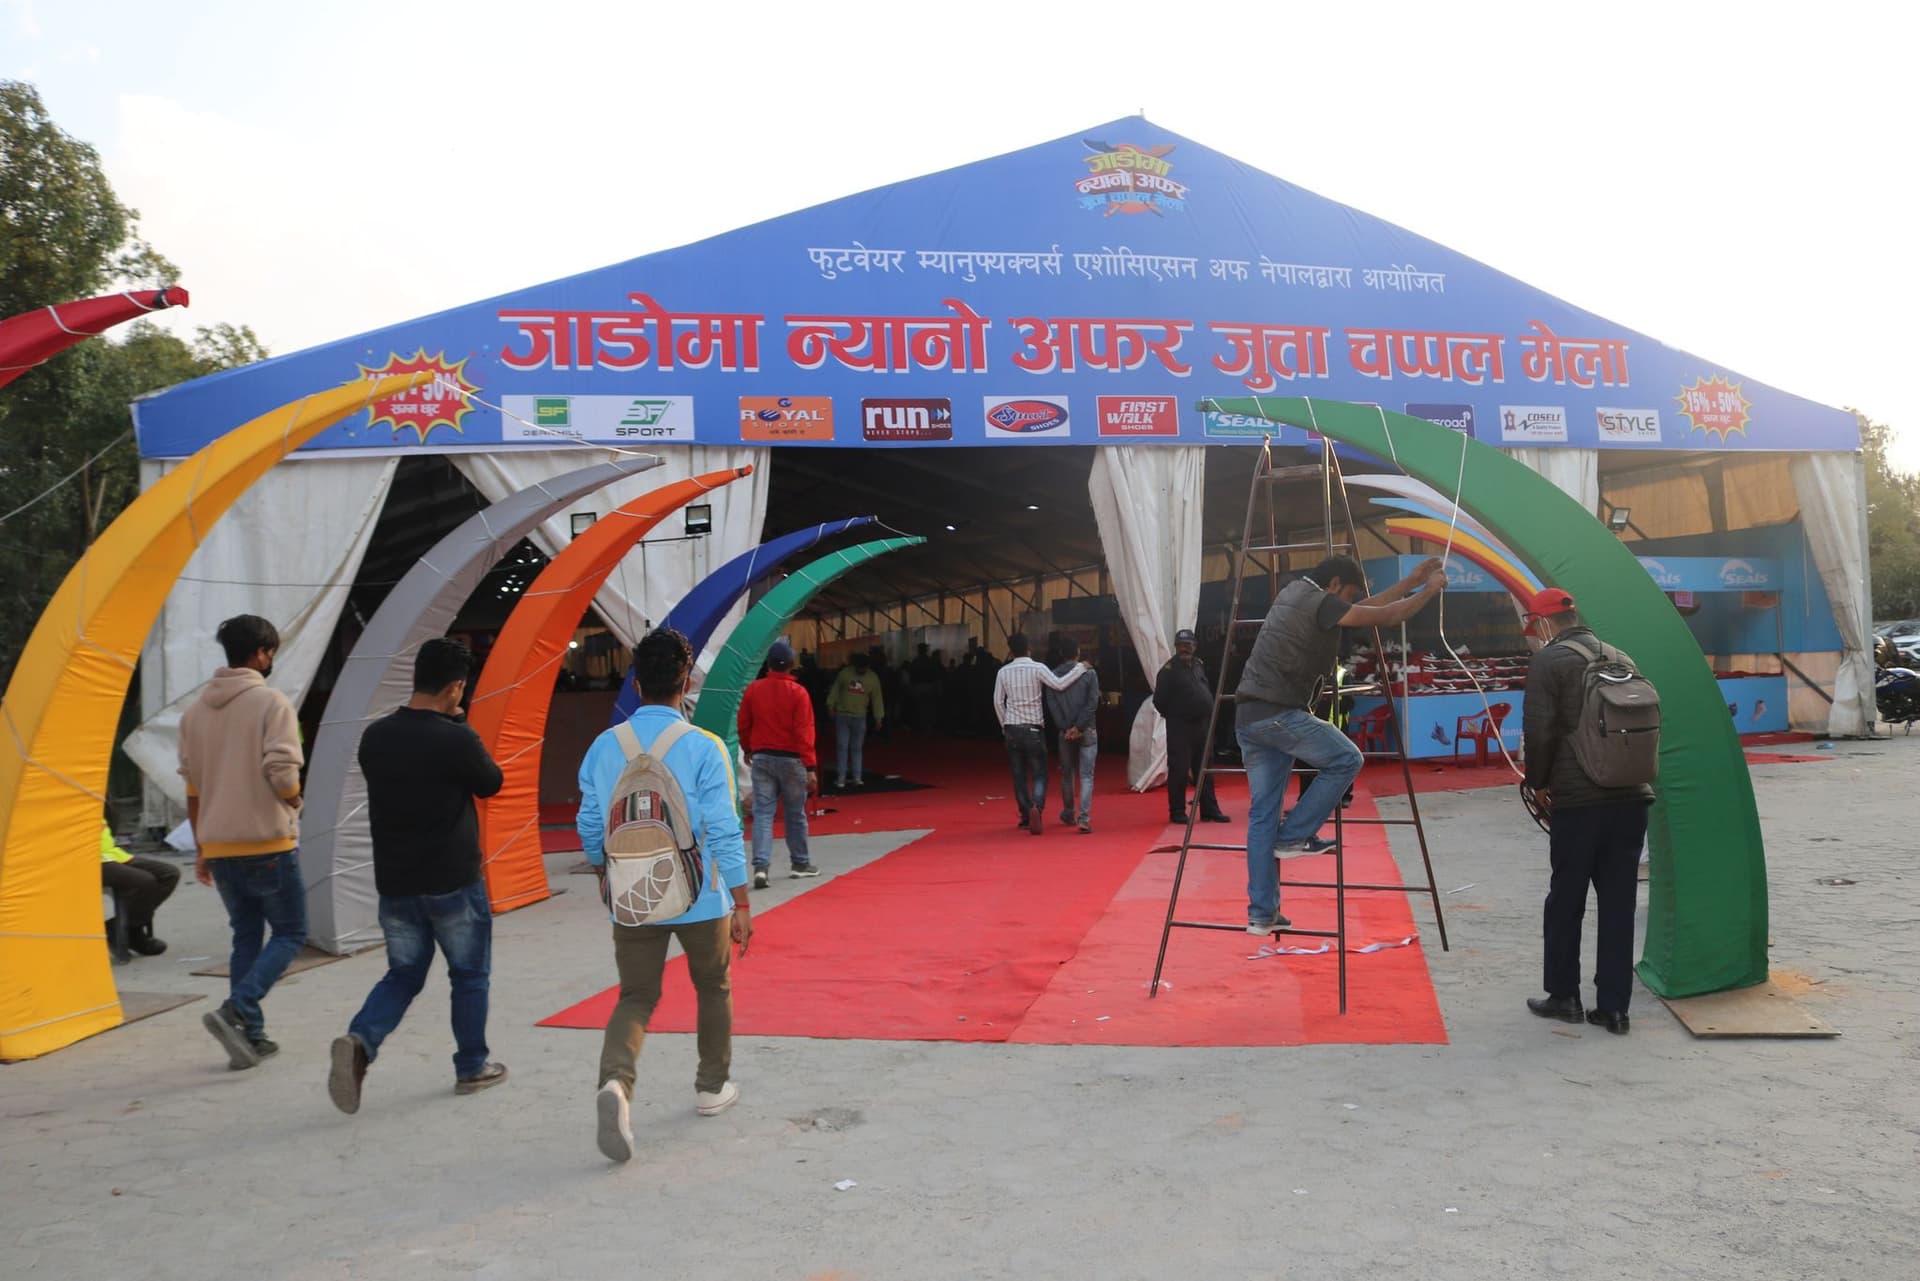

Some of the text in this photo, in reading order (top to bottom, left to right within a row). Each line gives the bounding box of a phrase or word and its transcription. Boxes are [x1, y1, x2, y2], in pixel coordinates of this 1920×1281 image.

[1083, 147, 1174, 176] जाडोमा
[1076, 169, 1190, 199] न्यानो अफर
[807, 240, 906, 280] फुटवेयर
[1073, 246, 1198, 282] एशोसिएसन
[1209, 258, 1251, 281] अफ
[1259, 254, 1352, 289] नेपालद्वारा
[1363, 263, 1446, 293] आयोजित
[498, 292, 765, 373] जाडोमा
[784, 297, 992, 374] न्यानो
[1008, 316, 1194, 378] अफर
[1344, 327, 1505, 386] चप्पल
[1518, 319, 1630, 389] मेला
[1120, 401, 1168, 413] FIRST
[865, 407, 930, 429] run
[1030, 418, 1060, 431] SHOES
[1106, 412, 1153, 424] WALK
[1603, 416, 1656, 431] STYLE
[616, 427, 676, 437] SPORT
